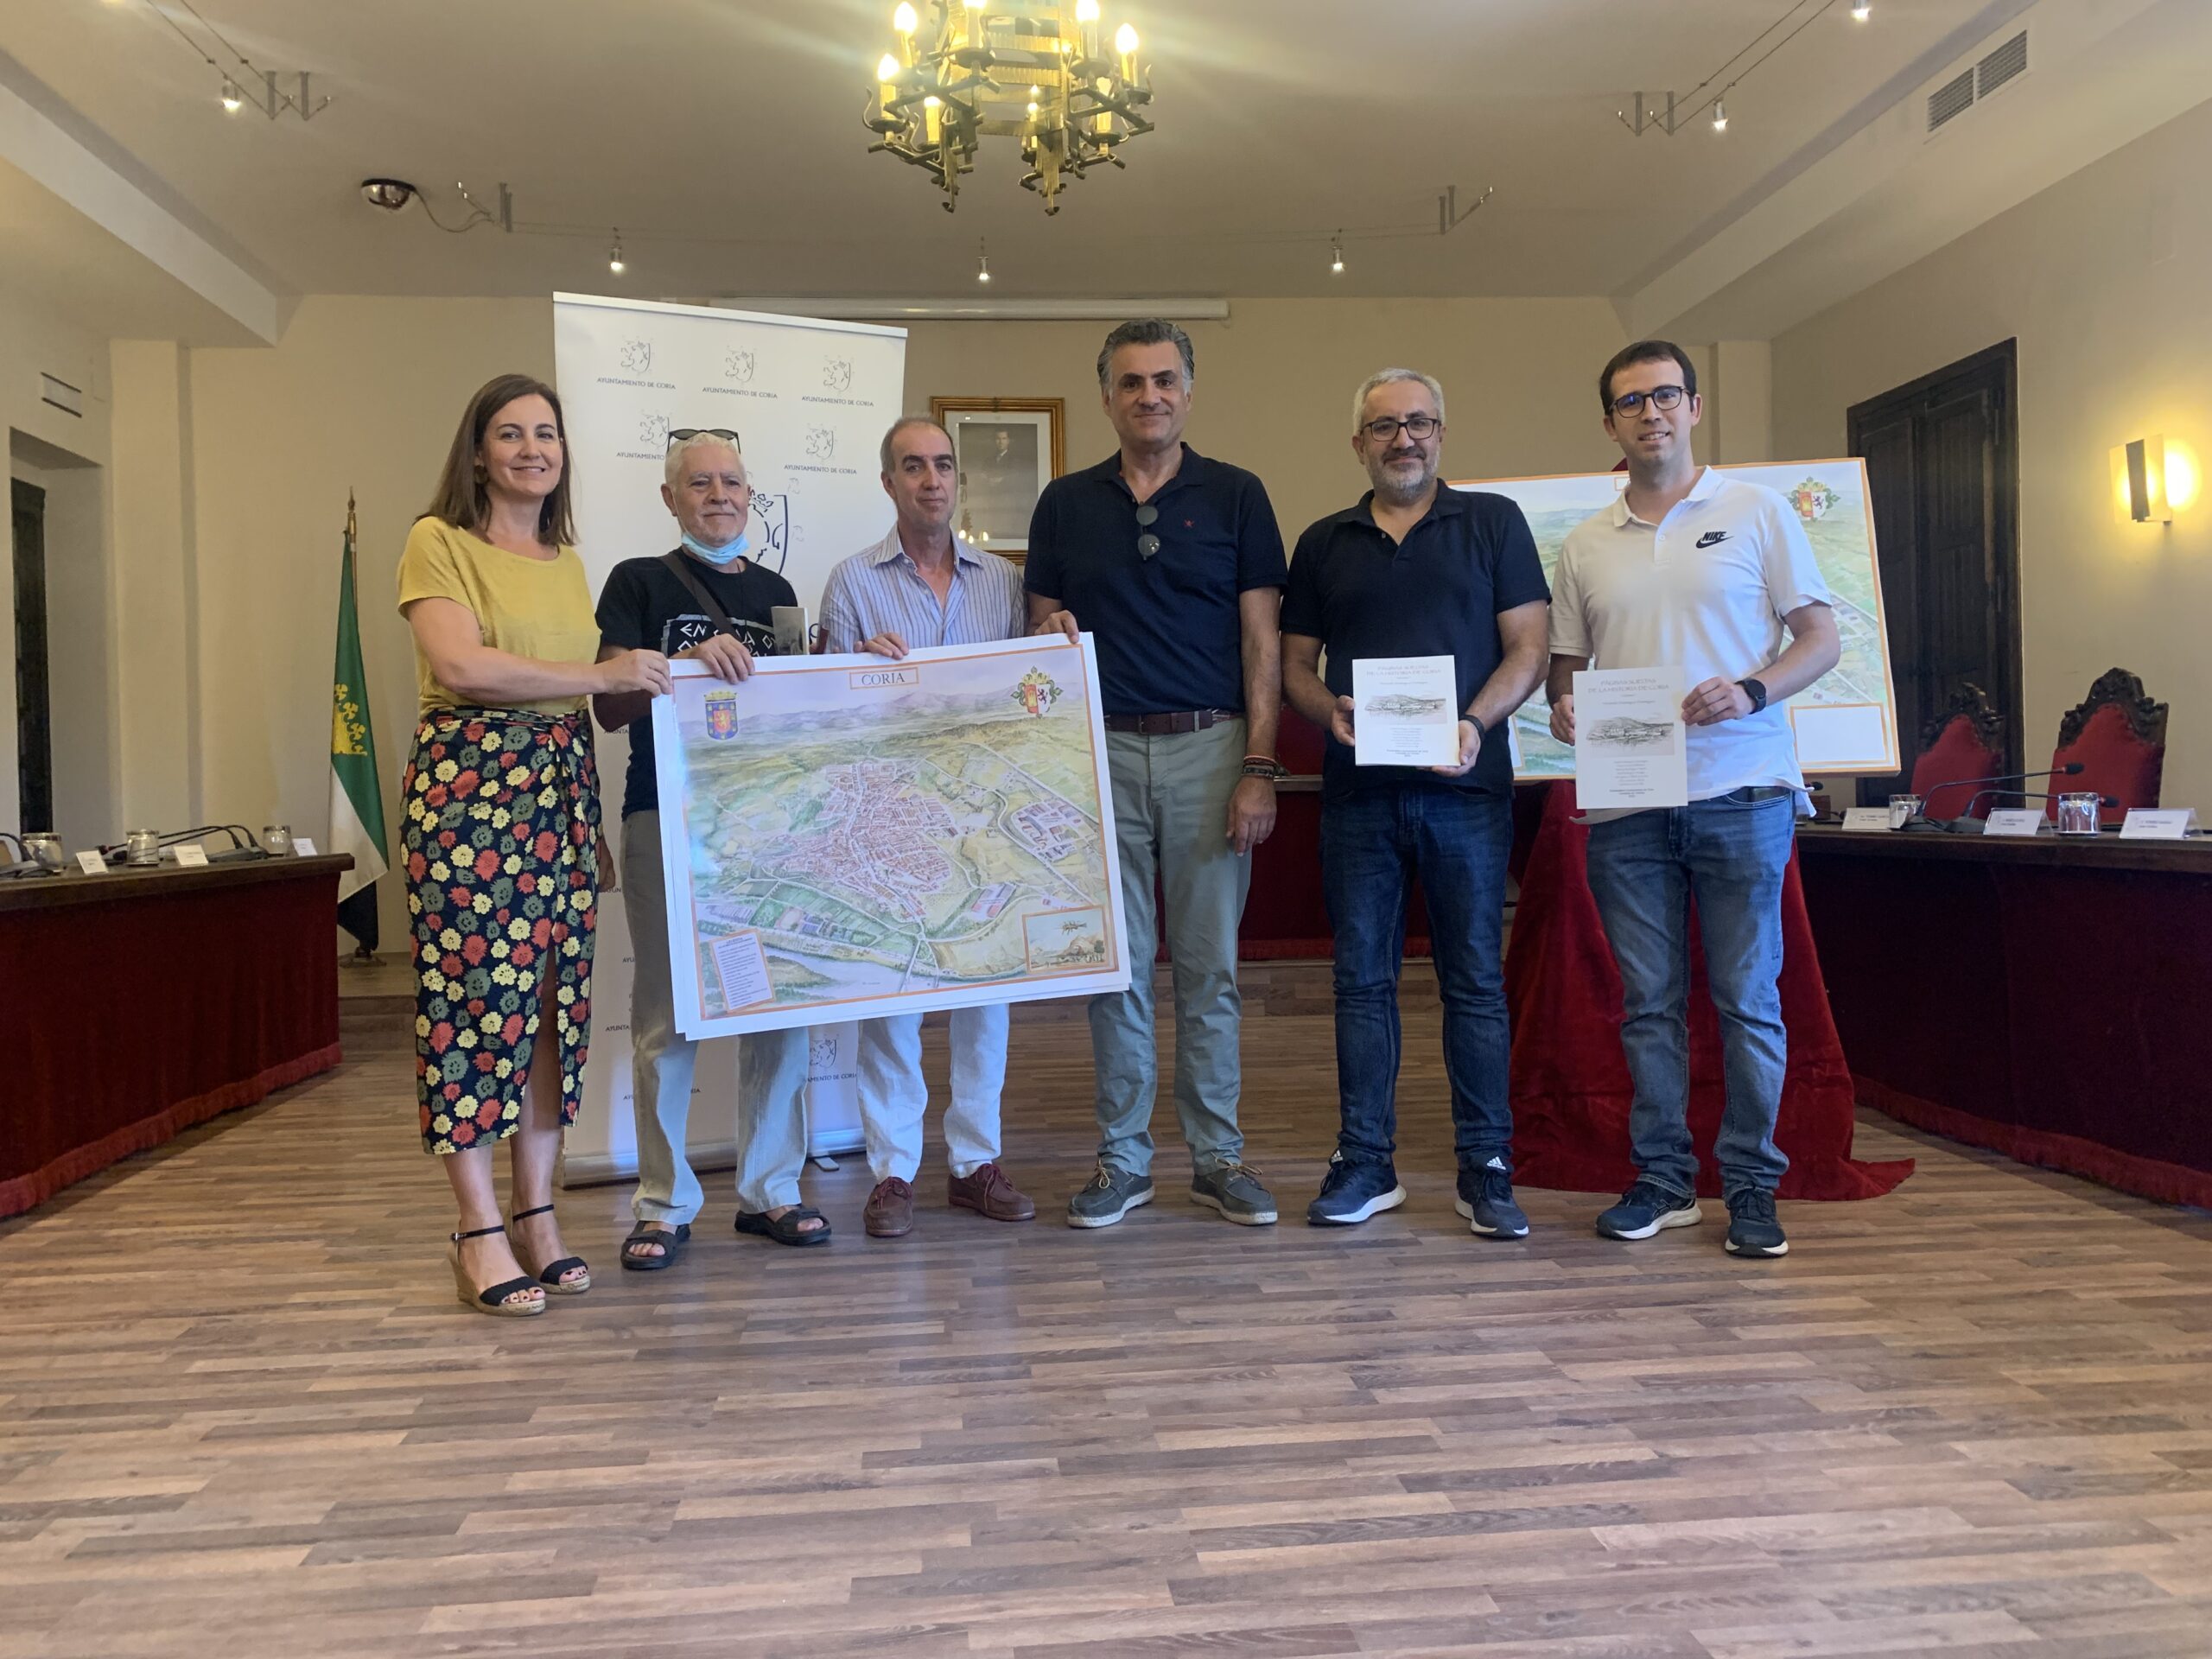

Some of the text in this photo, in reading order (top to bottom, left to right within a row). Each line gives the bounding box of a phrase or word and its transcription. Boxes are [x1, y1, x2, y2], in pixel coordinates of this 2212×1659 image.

[596, 377, 646, 388] AYUNTAMIENTO
[702, 387, 749, 397] AYUNTAMIENTO
[801, 396, 847, 405] AYUNTAMIENTO
[616, 452, 664, 461] AYUNTAMIENTO
[784, 464, 830, 474] AYUNTAMIENTO
[1702, 531, 1727, 542] NIKE
[861, 672, 906, 686] CORIA
